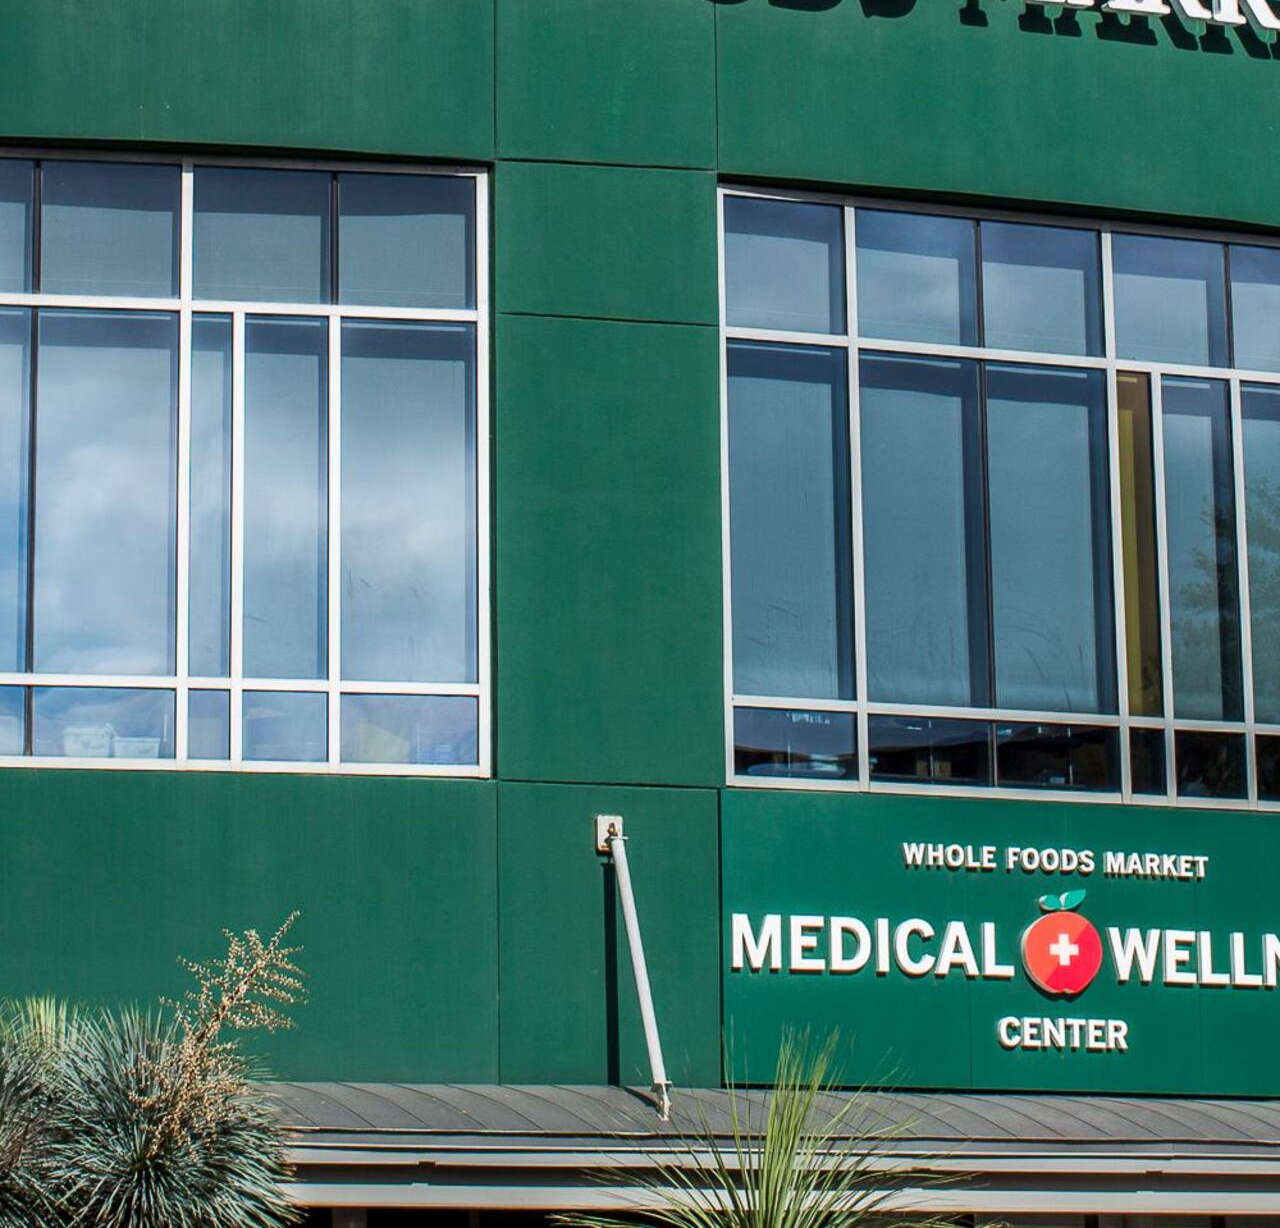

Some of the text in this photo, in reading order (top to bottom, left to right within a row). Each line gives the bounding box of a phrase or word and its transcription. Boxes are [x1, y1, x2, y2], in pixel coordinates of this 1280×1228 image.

[902, 842, 1210, 880] WHOLE FOODS MARKET
[730, 912, 1016, 978] MEDICAL
[998, 1015, 1129, 1050] CENTER
